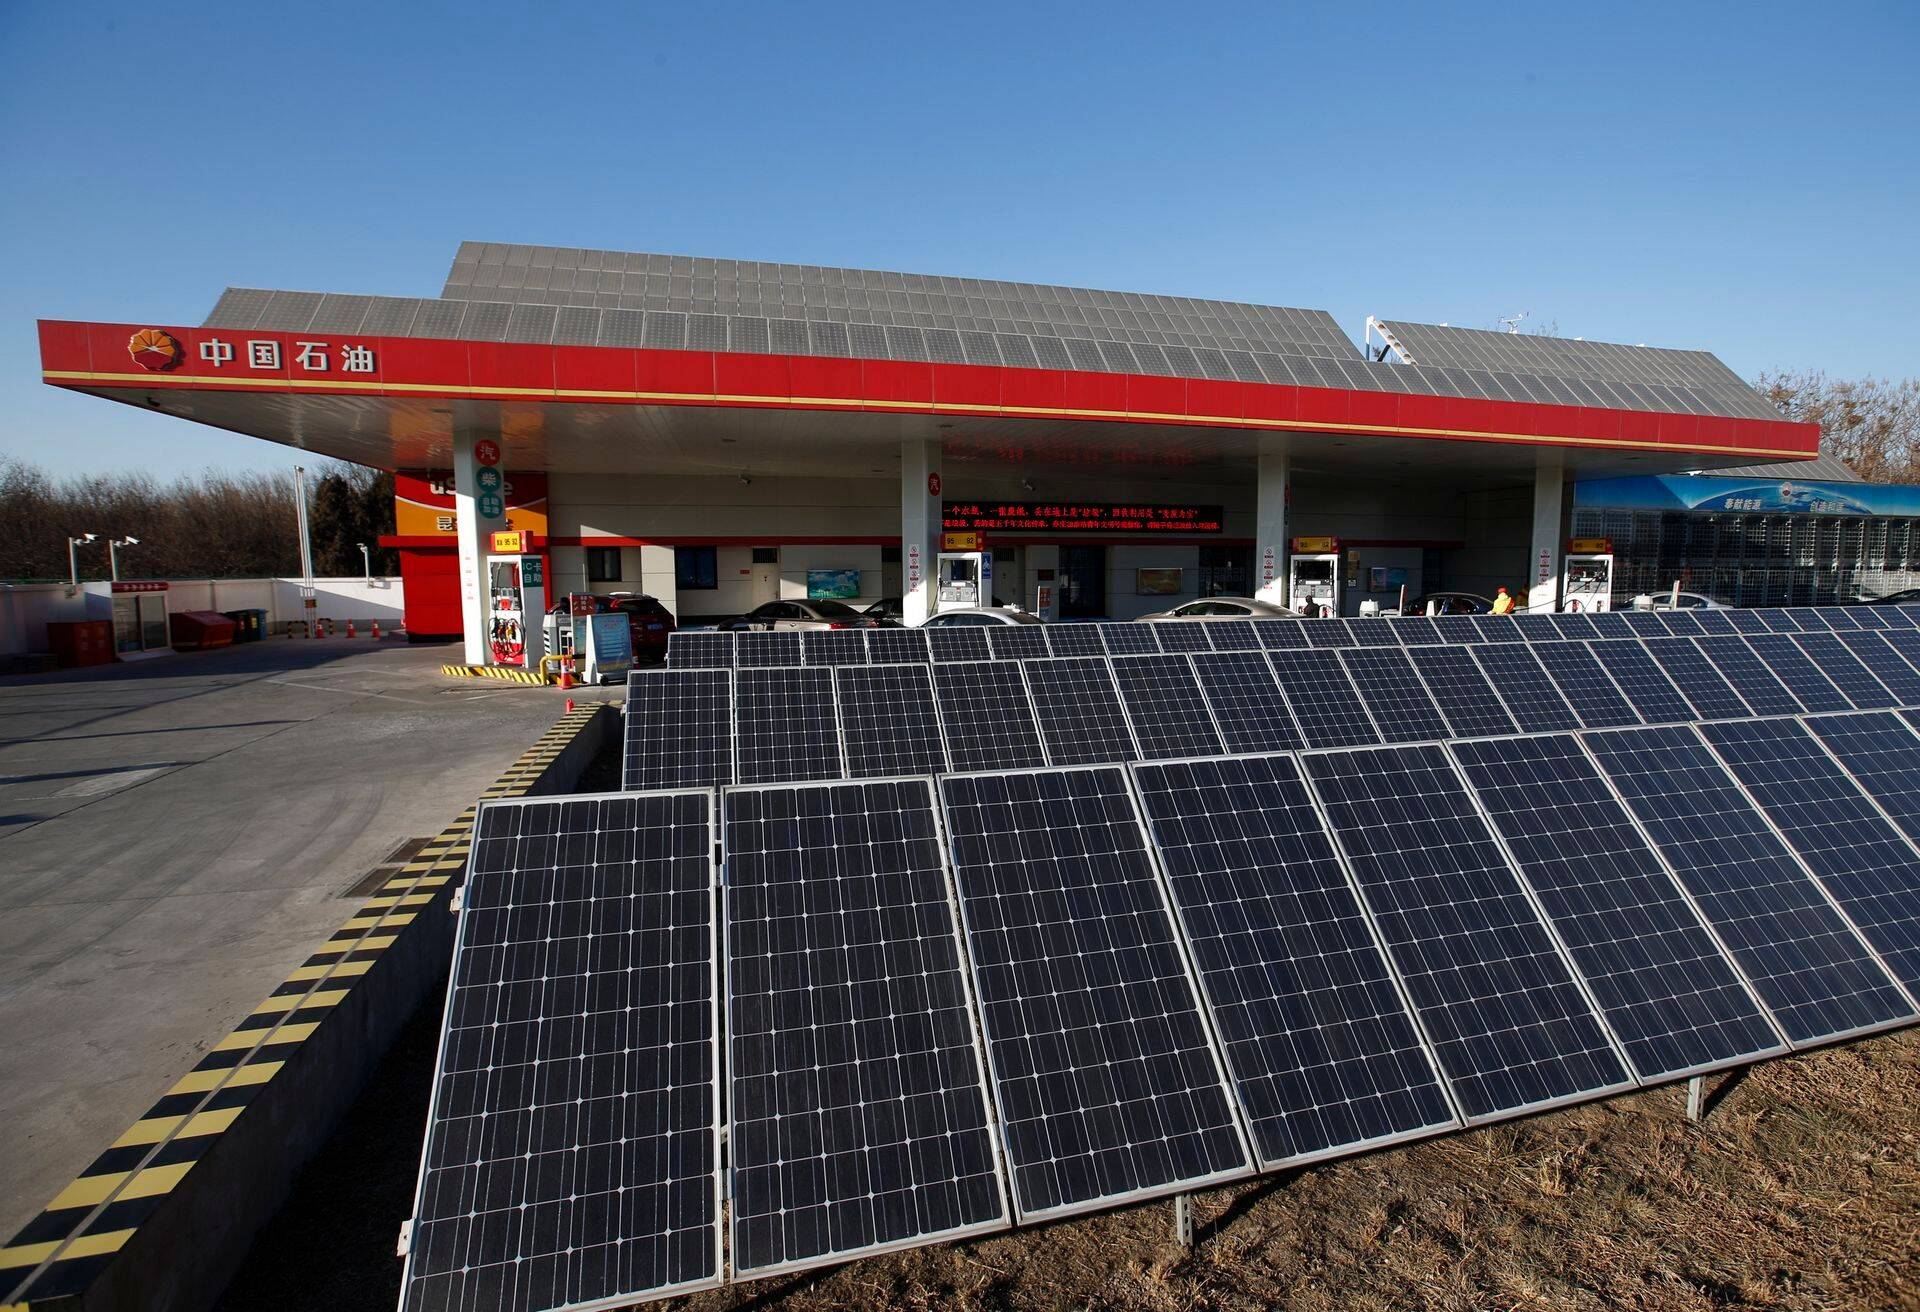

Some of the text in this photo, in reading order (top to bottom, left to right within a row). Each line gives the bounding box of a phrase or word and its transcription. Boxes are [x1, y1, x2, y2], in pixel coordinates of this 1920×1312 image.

[200, 338, 374, 373] 中国石油
[480, 444, 496, 460] 汽
[481, 472, 497, 487] 柴
[930, 478, 939, 491] 汽
[1724, 498, 1762, 511] 奉献能源
[946, 537, 974, 545] 95 92
[522, 562, 542, 572] IC卡
[524, 573, 543, 583] 自助
